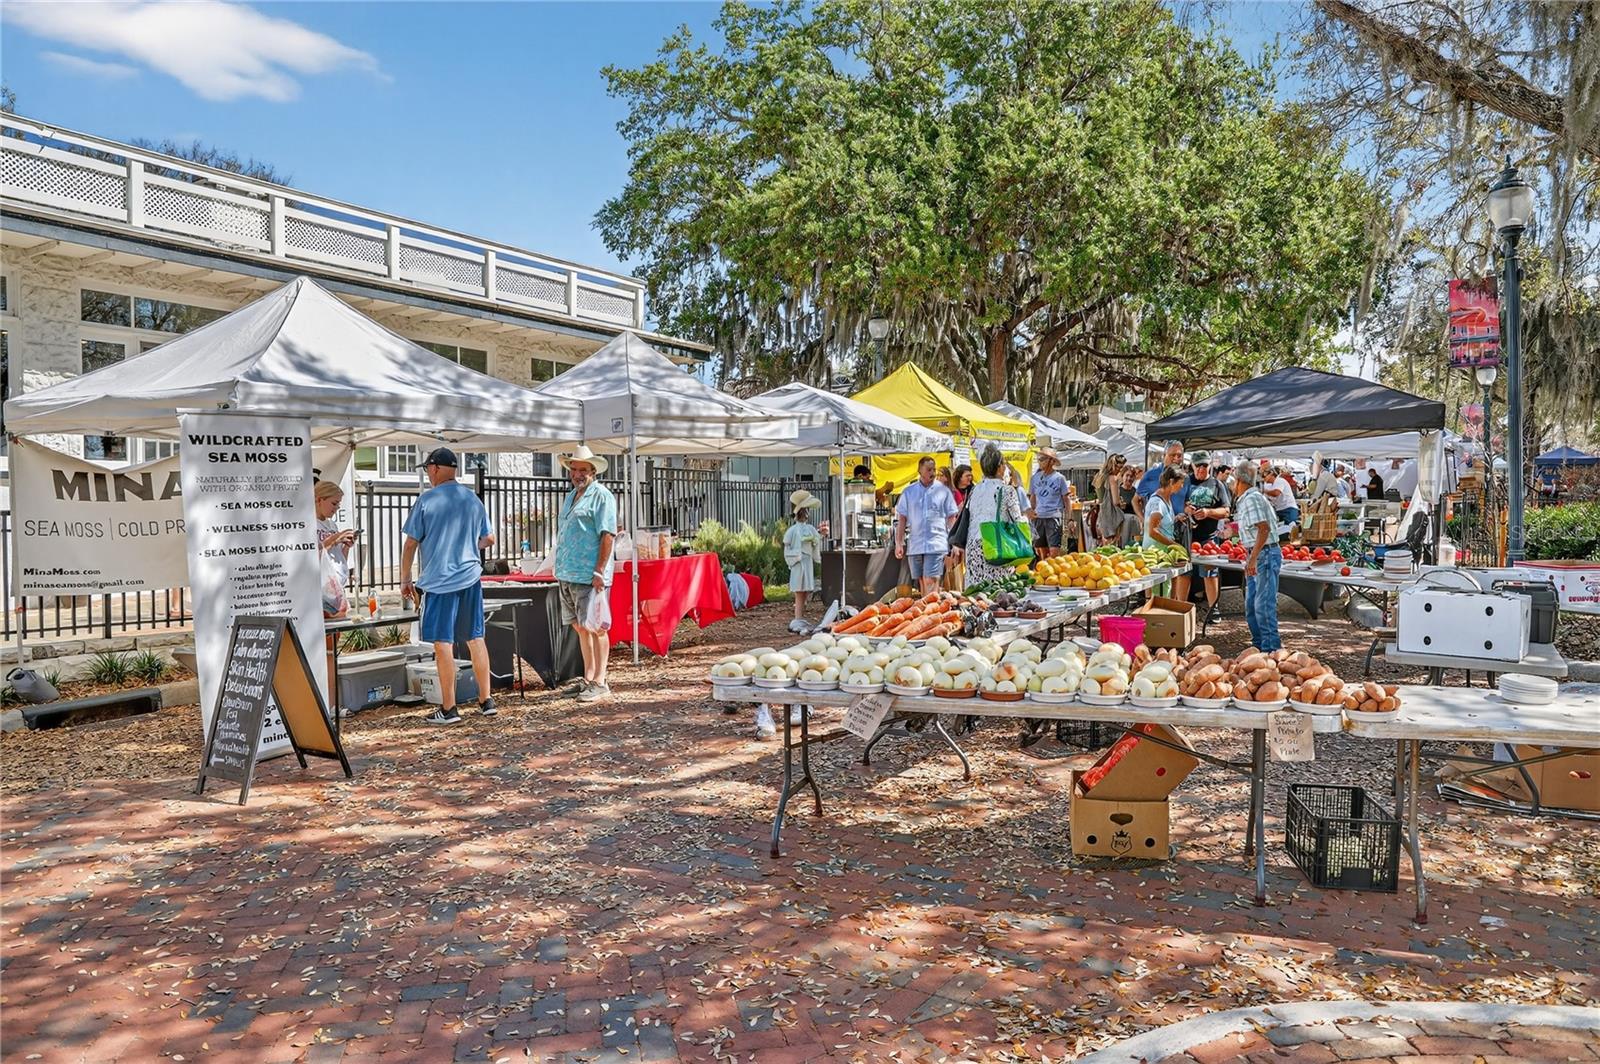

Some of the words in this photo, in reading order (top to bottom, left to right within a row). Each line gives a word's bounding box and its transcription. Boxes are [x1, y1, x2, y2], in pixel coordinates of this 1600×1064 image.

[188, 434, 304, 447] WILDCRAFTED
[208, 452, 241, 463] SEA
[245, 452, 288, 463] MOSS
[196, 475, 252, 484] NATURALLY
[254, 475, 303, 483] FLAVORED
[51, 469, 182, 502] MINA
[200, 485, 227, 493] WITH
[228, 483, 271, 493] ORGANIC
[272, 483, 300, 491] FRUIT
[220, 502, 242, 510] SEA
[244, 501, 272, 509] MOSS
[274, 500, 294, 508] GEL
[24, 519, 60, 537] SEA
[65, 521, 104, 538] MOSS
[118, 520, 159, 537] COLD
[212, 523, 268, 533] WELLNESS
[270, 521, 305, 531] SHOTS
[204, 549, 226, 557] SEA
[228, 546, 257, 556] MOSS
[259, 542, 316, 554] LEMONADE
[23, 567, 101, 577] MinaMoss.com
[23, 578, 145, 589] minaseamoss@gmail.com
